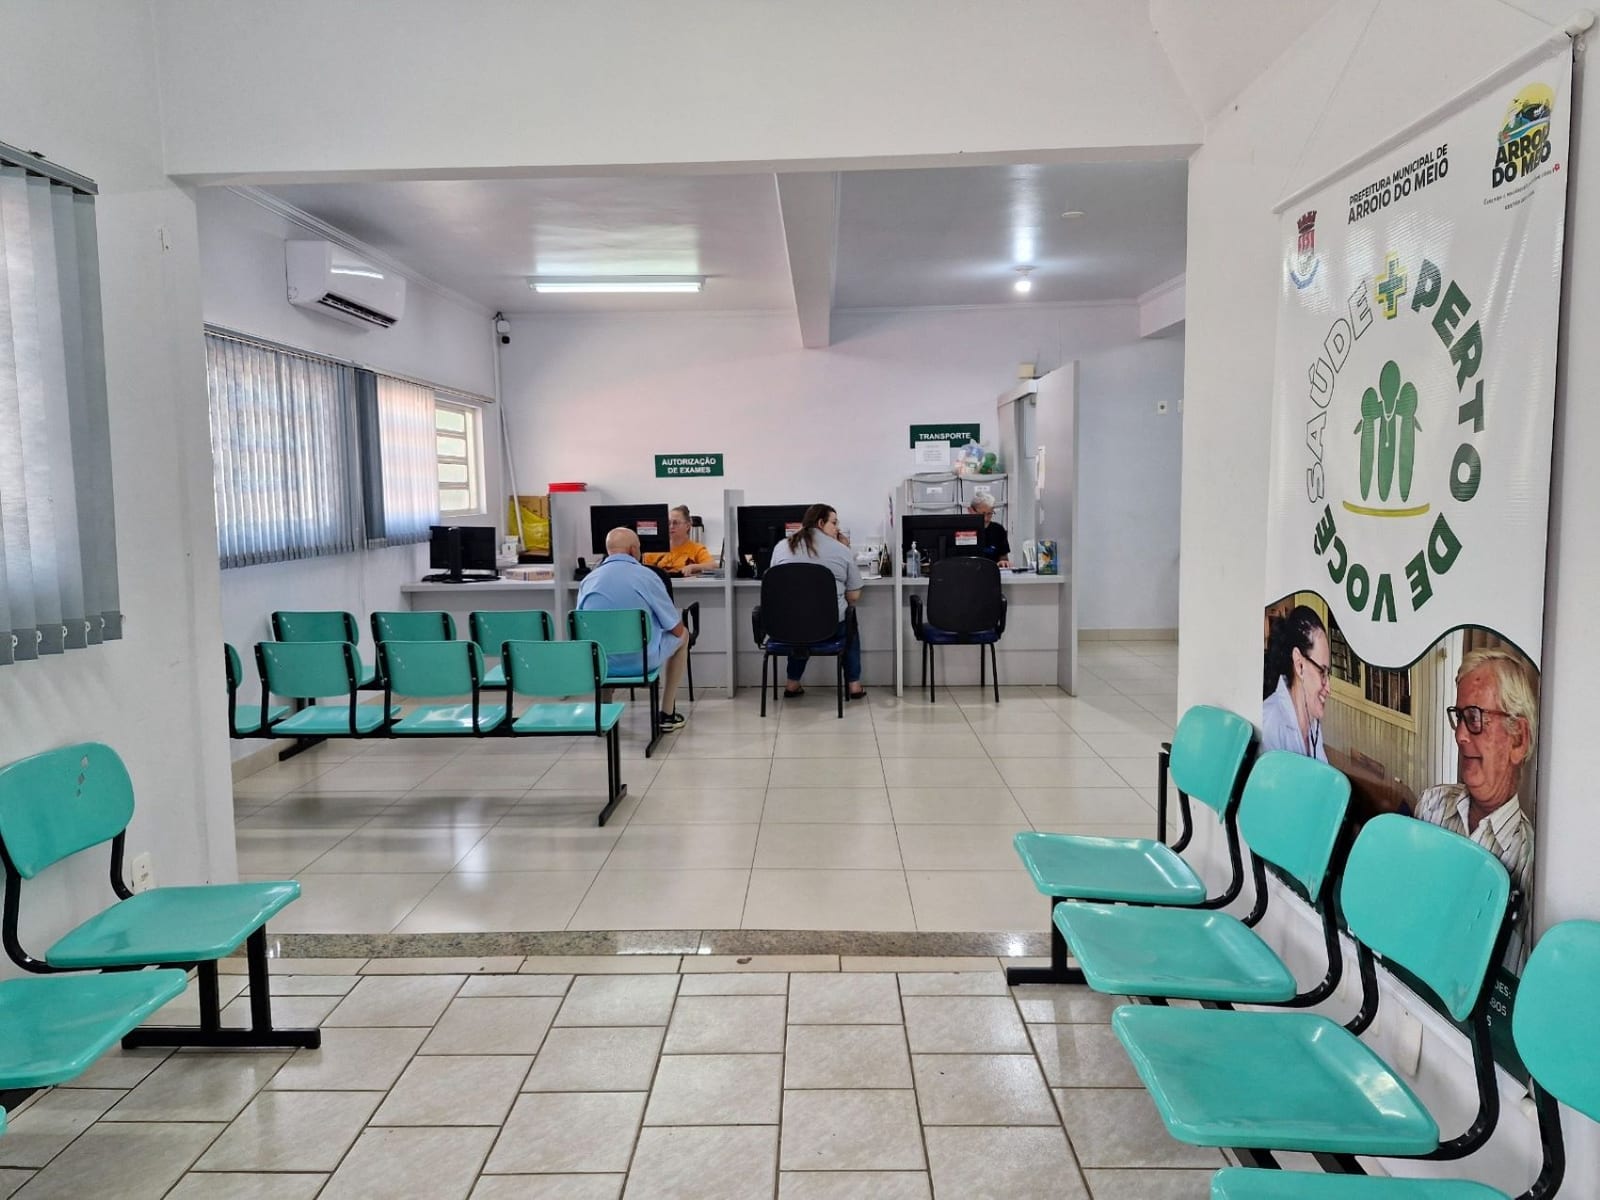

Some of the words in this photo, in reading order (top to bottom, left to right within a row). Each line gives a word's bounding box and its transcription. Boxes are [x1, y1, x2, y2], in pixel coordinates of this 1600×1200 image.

[1349, 176, 1391, 206] PREFEITURA
[1392, 151, 1434, 183] MUNICIPAL
[1436, 143, 1448, 160] DE
[1492, 161, 1518, 188] DO
[1520, 140, 1551, 177] MEO
[1495, 126, 1550, 168] ARRO
[1347, 188, 1391, 225] ARROIO
[1394, 177, 1411, 202] DO
[1414, 157, 1449, 192] MEIO
[1306, 280, 1374, 503] SAÚDE
[1411, 258, 1485, 502] PERTO
[661, 456, 717, 467] AUTORIZAÇÃO
[918, 432, 972, 441] TRANSPORTE
[667, 466, 678, 474] DE
[680, 466, 711, 474] EXAMES
[1313, 504, 1398, 623] VOCÊ
[1405, 512, 1463, 612] DE
